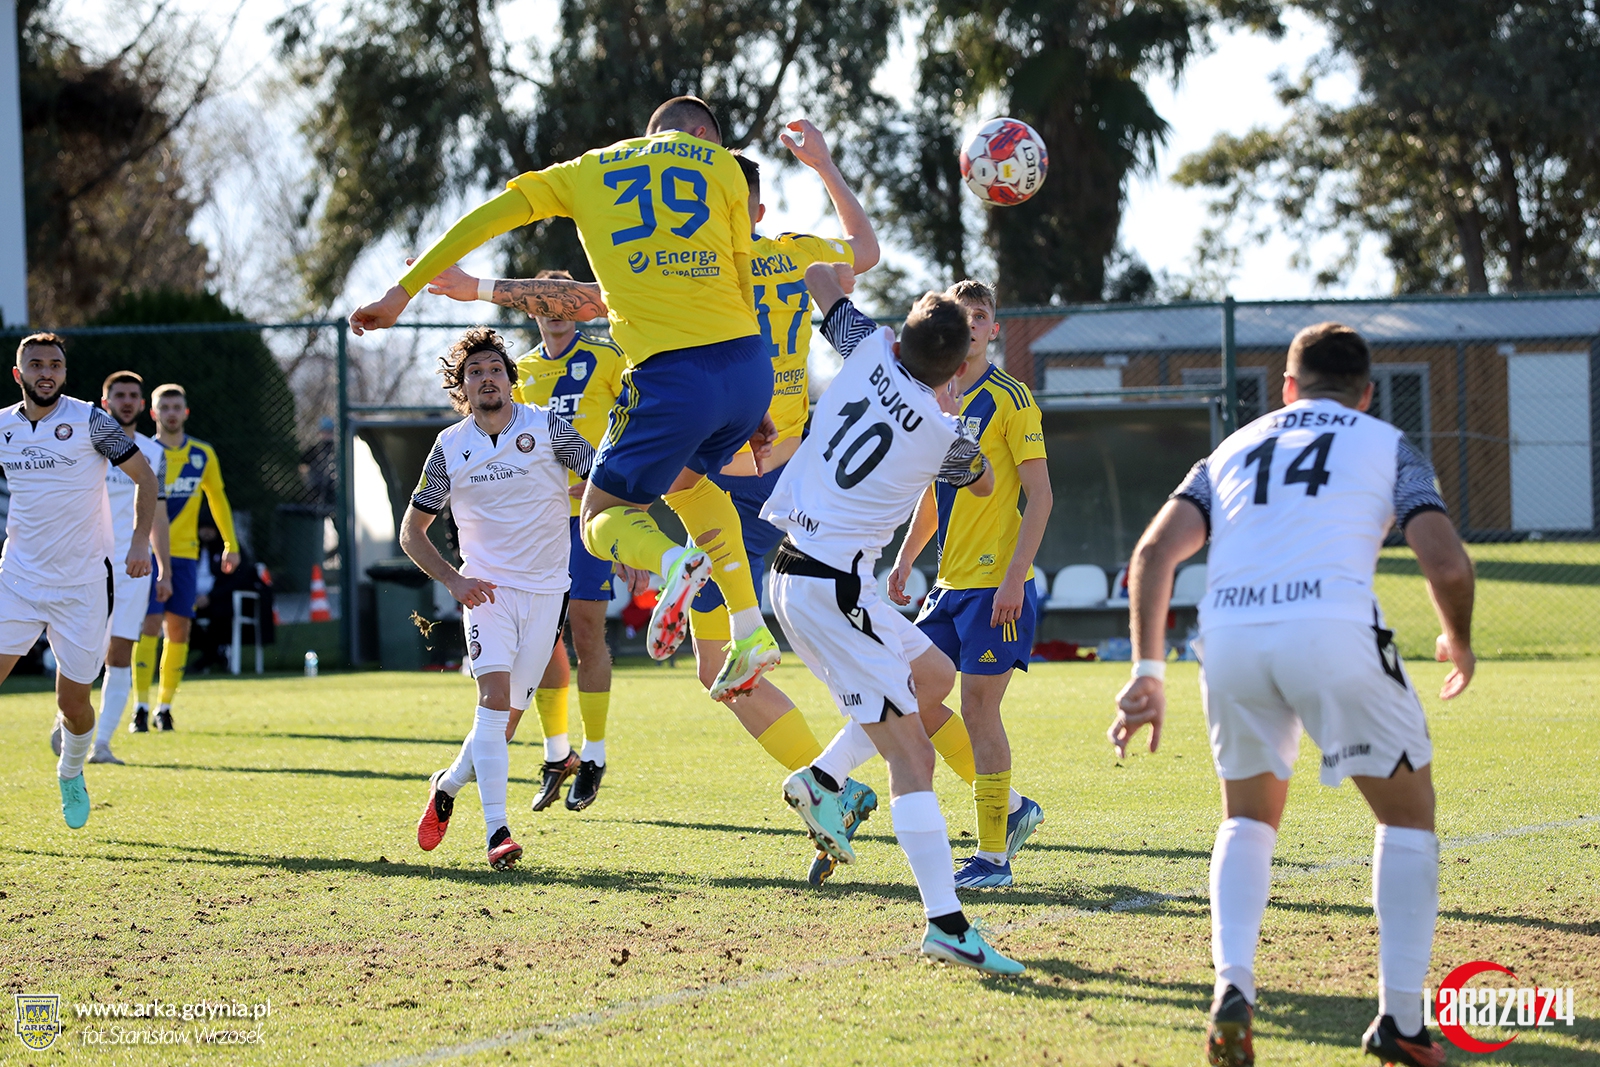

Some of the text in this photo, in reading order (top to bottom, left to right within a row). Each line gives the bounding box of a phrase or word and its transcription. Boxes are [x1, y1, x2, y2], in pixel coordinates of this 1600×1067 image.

[1022, 146, 1036, 190] SELECT
[603, 164, 710, 247] 39
[656, 250, 717, 267] Energa
[662, 269, 690, 277] GPA
[773, 367, 805, 385] nerga
[869, 363, 923, 433] BOJKU
[823, 396, 894, 490] 10
[25, 460, 31, 470] &
[33, 460, 55, 469] LUM
[470, 470, 513, 483] TRIM & LUM
[1243, 432, 1336, 505] 14
[1213, 579, 1323, 608] TRIM LUM
